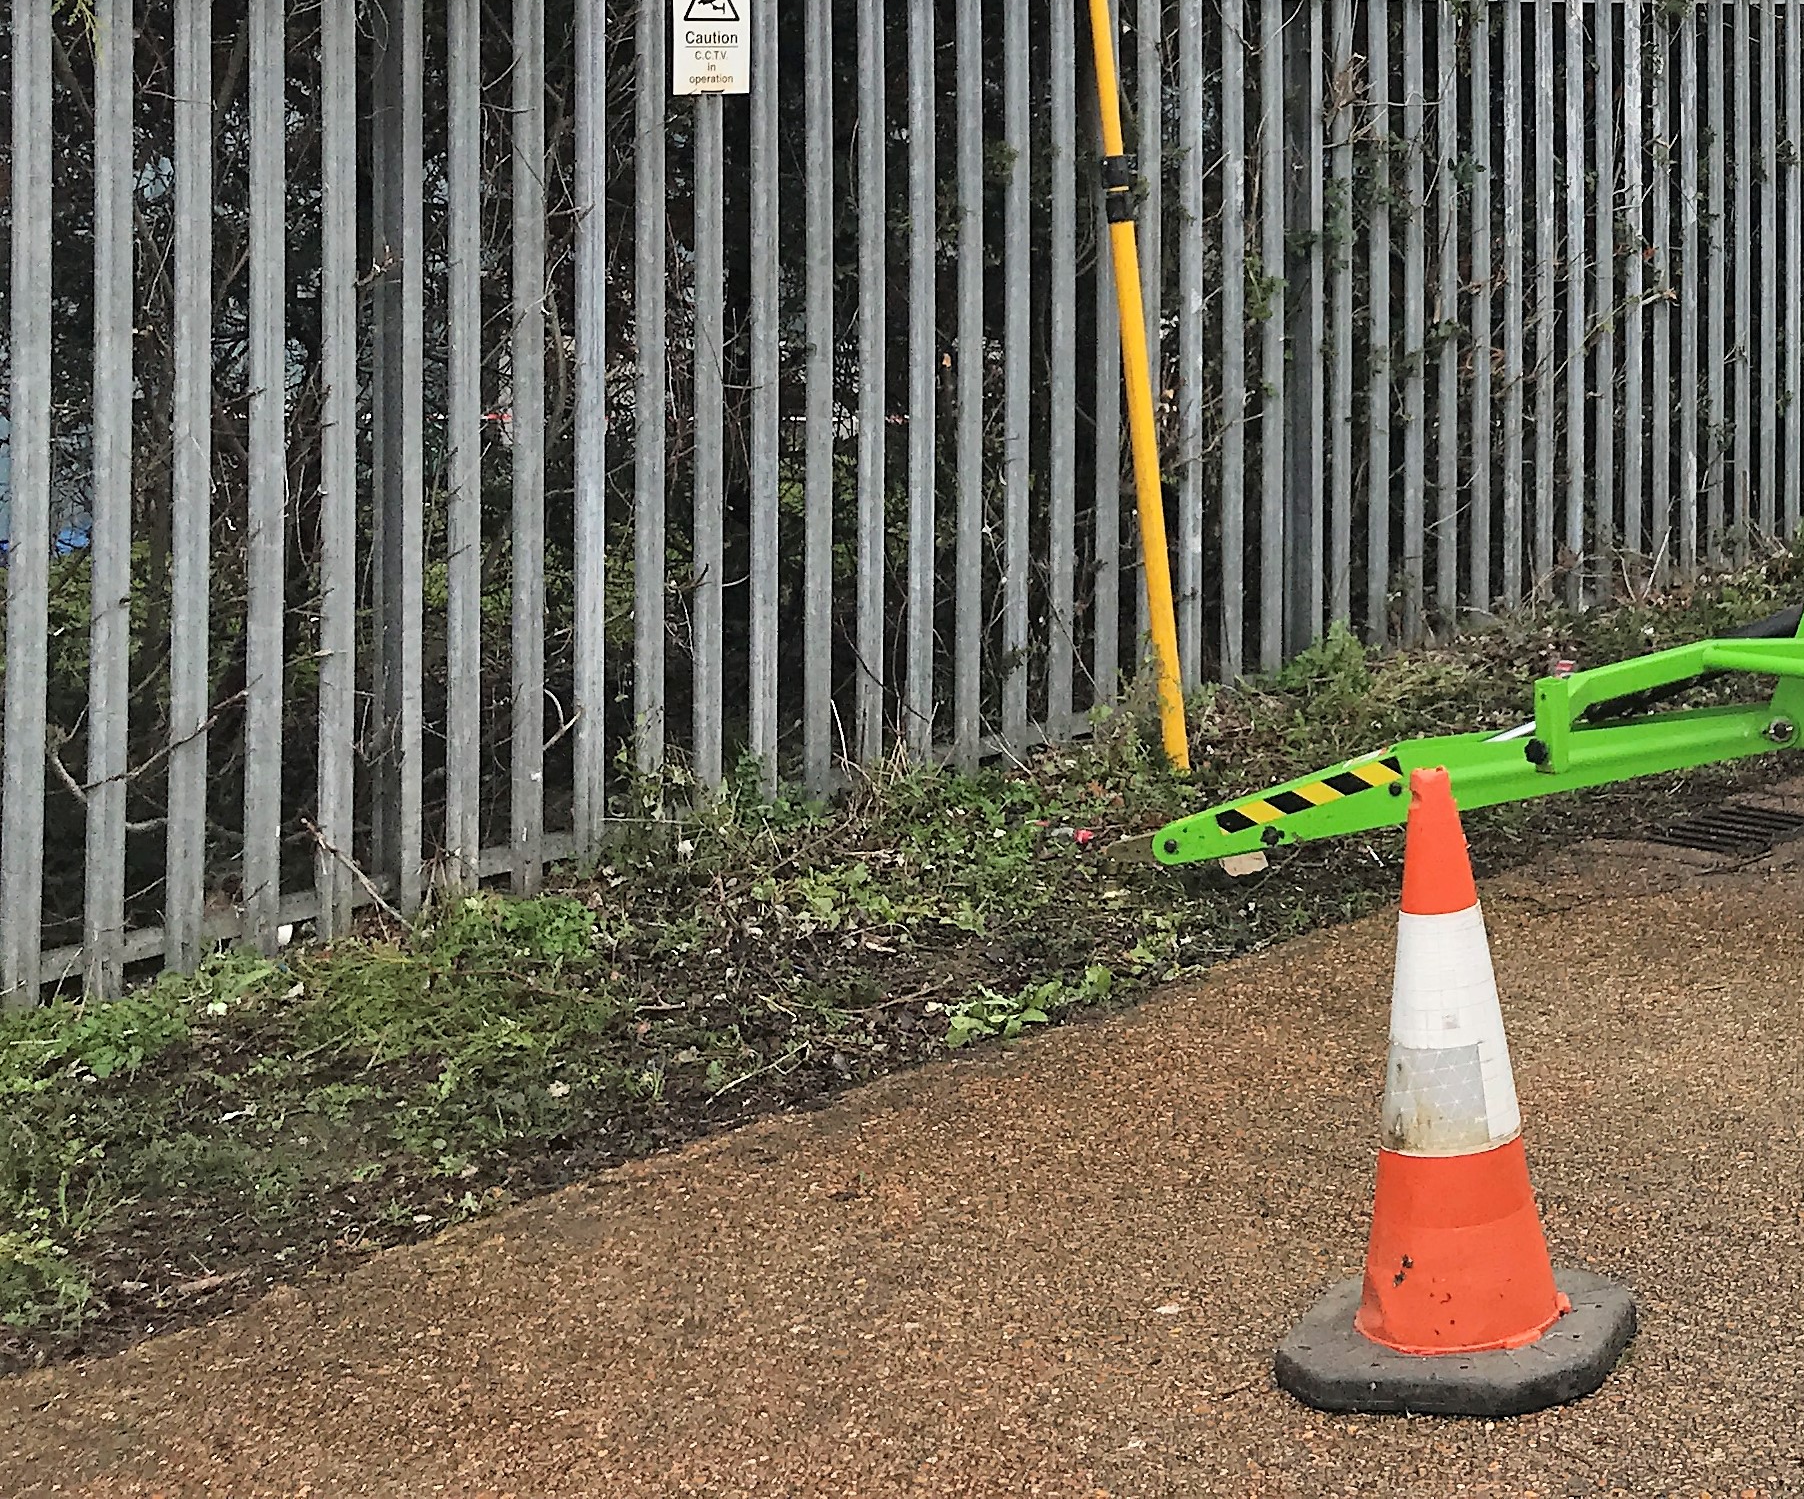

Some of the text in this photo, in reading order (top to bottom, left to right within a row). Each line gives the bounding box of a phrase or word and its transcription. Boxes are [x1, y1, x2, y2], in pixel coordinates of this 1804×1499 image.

[685, 31, 737, 44] Caution
[707, 63, 716, 72] in
[689, 75, 733, 85] operation
